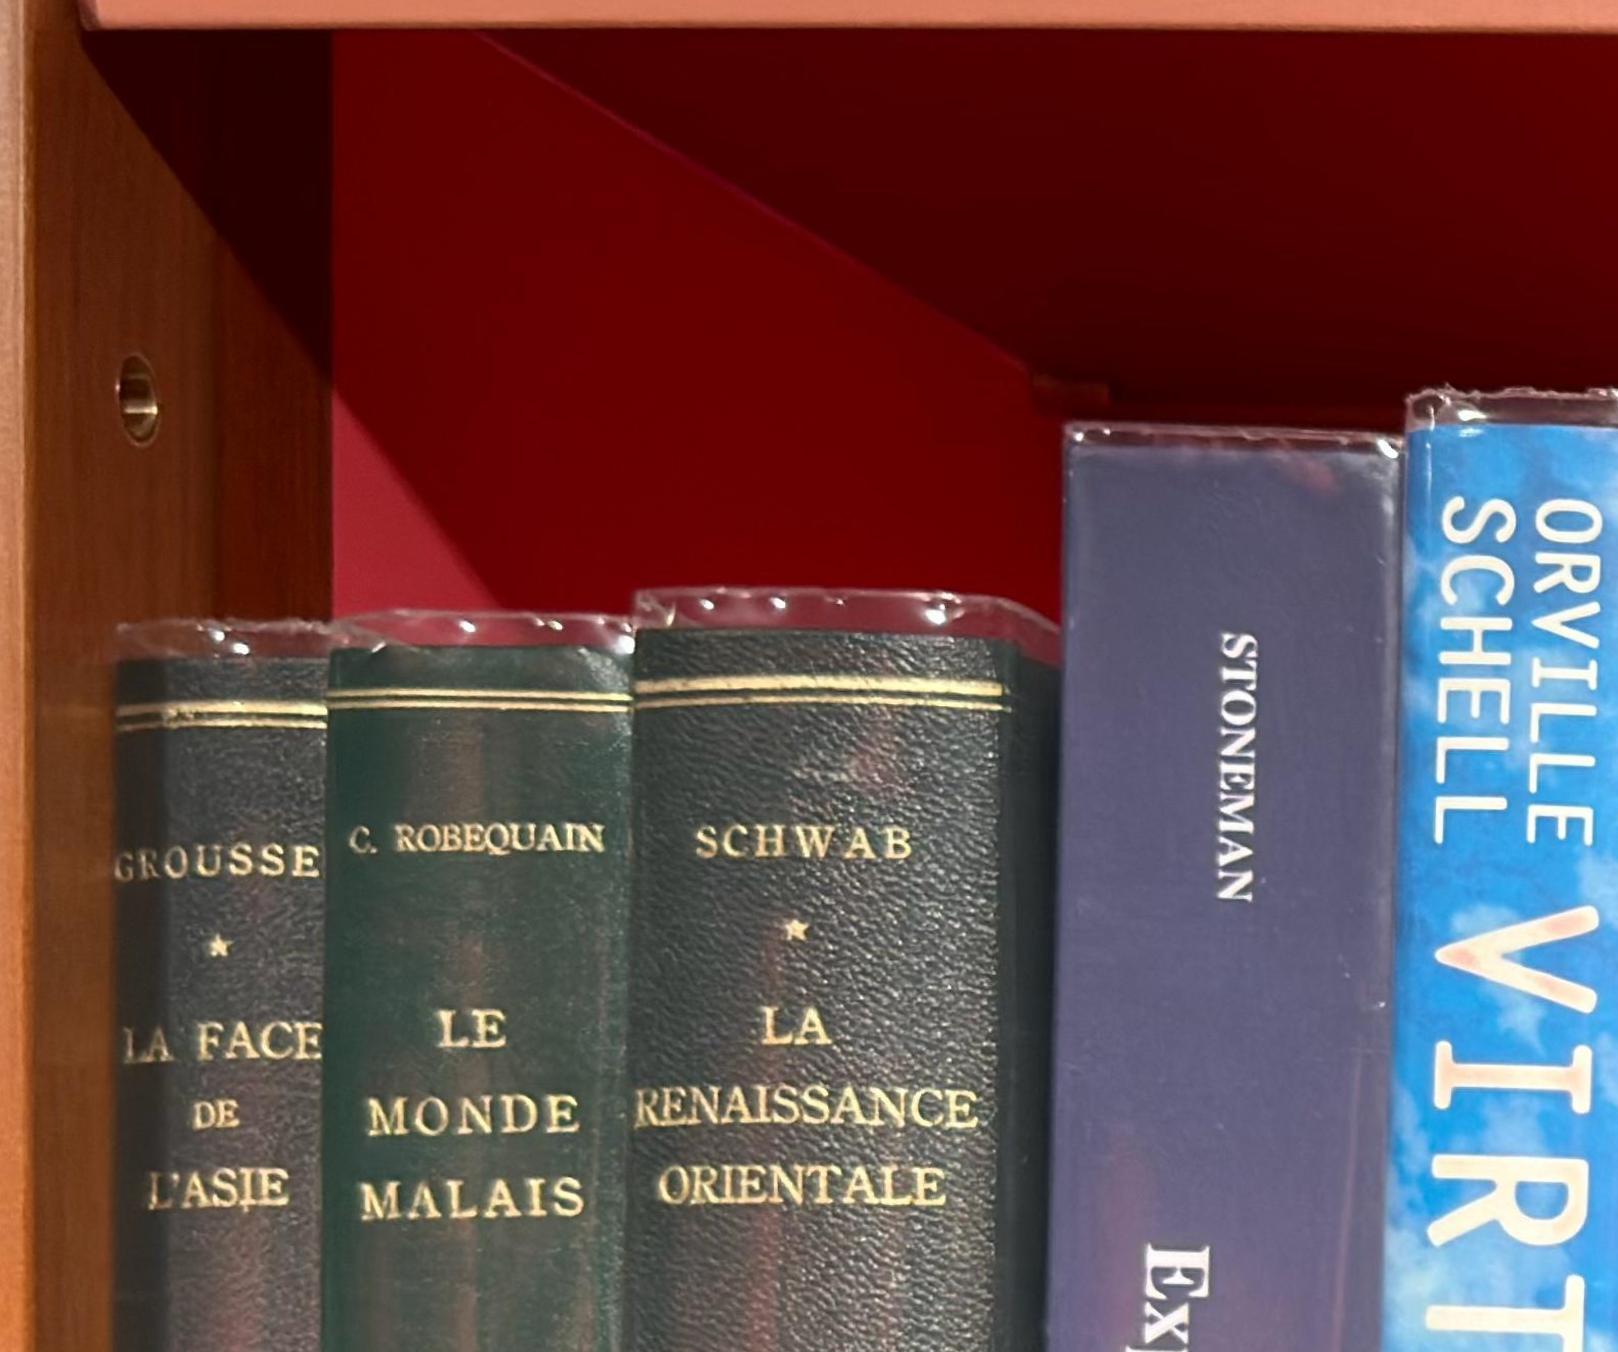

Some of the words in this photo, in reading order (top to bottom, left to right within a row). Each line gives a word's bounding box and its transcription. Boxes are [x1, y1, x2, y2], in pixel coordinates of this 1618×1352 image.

[1433, 496, 1517, 845] SCHELL
[1526, 498, 1602, 848] ORVILLE
[1216, 631, 1259, 903] STONEMAN
[348, 826, 378, 856] C.
[395, 822, 605, 856] ROBEQUAIN
[695, 824, 913, 862] SCHWAB
[113, 842, 321, 883] GROUSSE
[122, 1025, 175, 1064] LA
[196, 1020, 322, 1061] FACE
[437, 1009, 508, 1049] LE
[762, 1005, 833, 1047] LA
[191, 1099, 240, 1131] DE
[367, 1094, 580, 1137] MONDE
[632, 1085, 980, 1131] RENAISSANCE
[147, 1165, 290, 1212] L'ASIE
[360, 1175, 585, 1221] MALAIS
[658, 1162, 948, 1207] ORIENTALE
